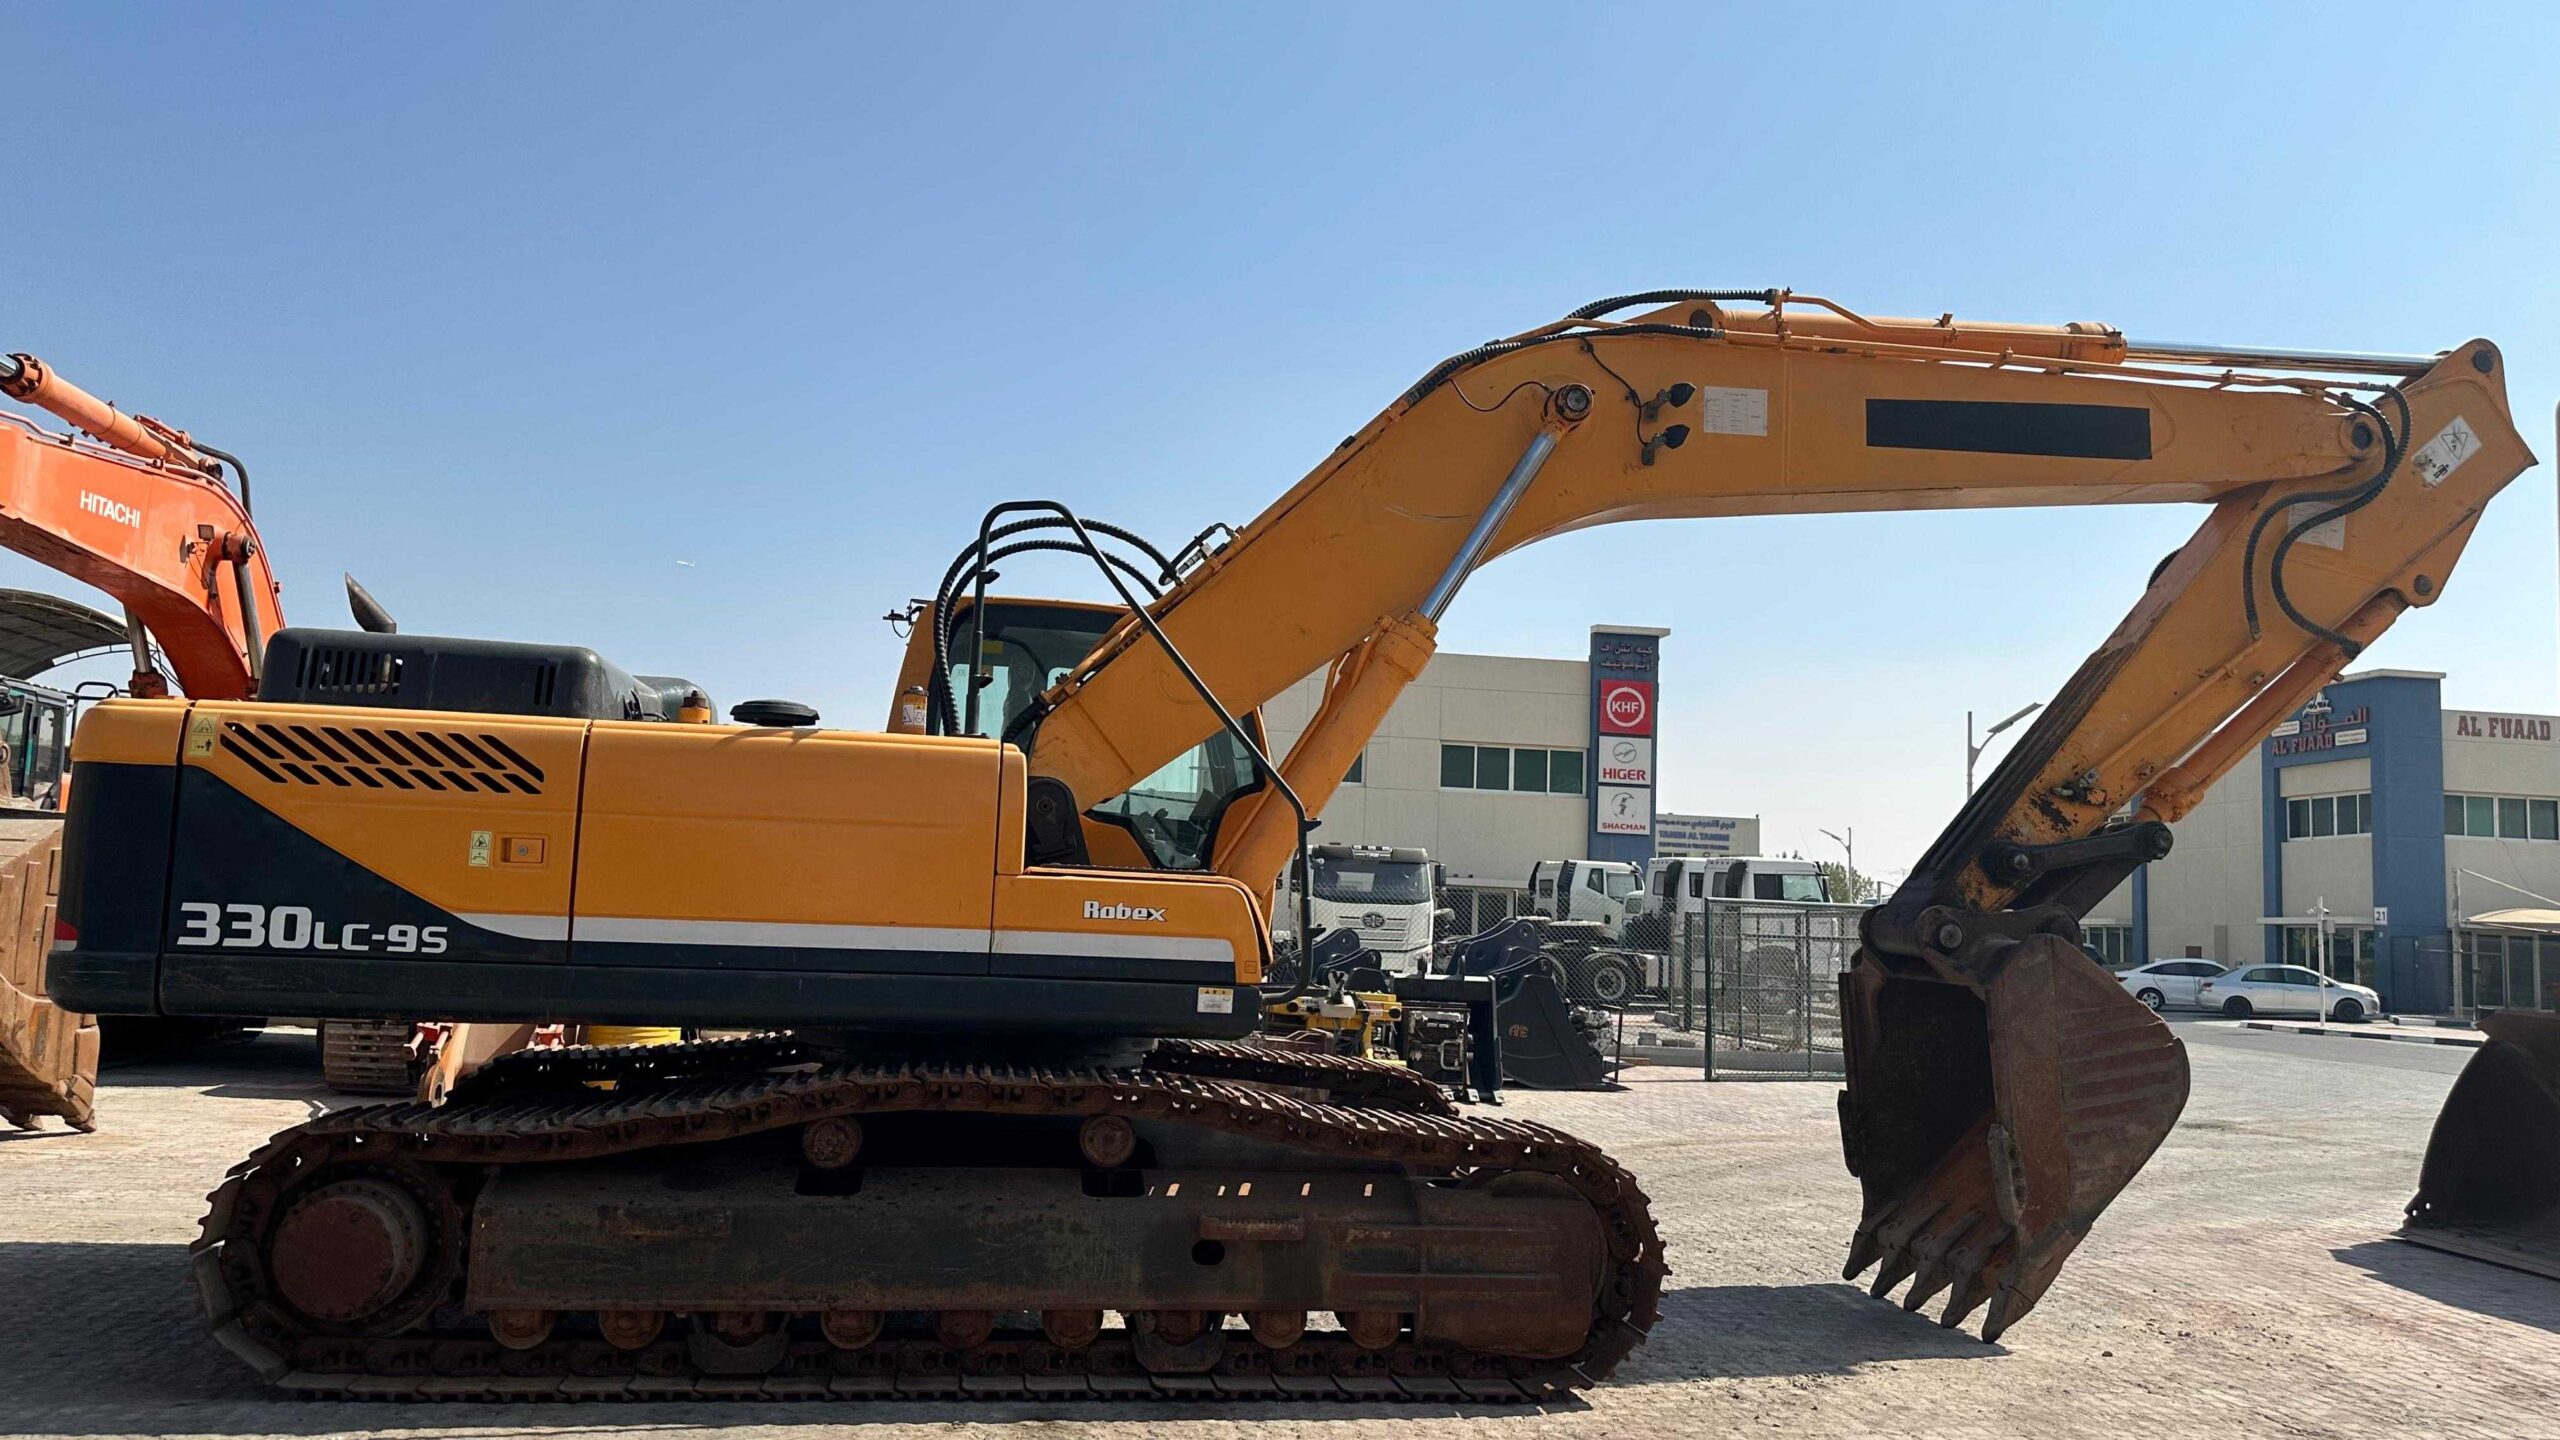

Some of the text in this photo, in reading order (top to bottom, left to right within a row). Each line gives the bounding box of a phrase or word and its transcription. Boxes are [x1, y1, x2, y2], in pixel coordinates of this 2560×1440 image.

[80, 488, 141, 529] HITACHI
[1611, 700, 1640, 714] KHF
[2457, 715, 2551, 741] AL FUAAD
[2272, 739, 2287, 756] AL
[2291, 733, 2333, 753] FUAAD
[1603, 768, 1646, 781] HIGER
[1602, 822, 1646, 831] SHACMAN
[1083, 900, 1168, 922] Robex
[2376, 911, 2386, 921] 21
[177, 902, 448, 953] 330LC-9S
